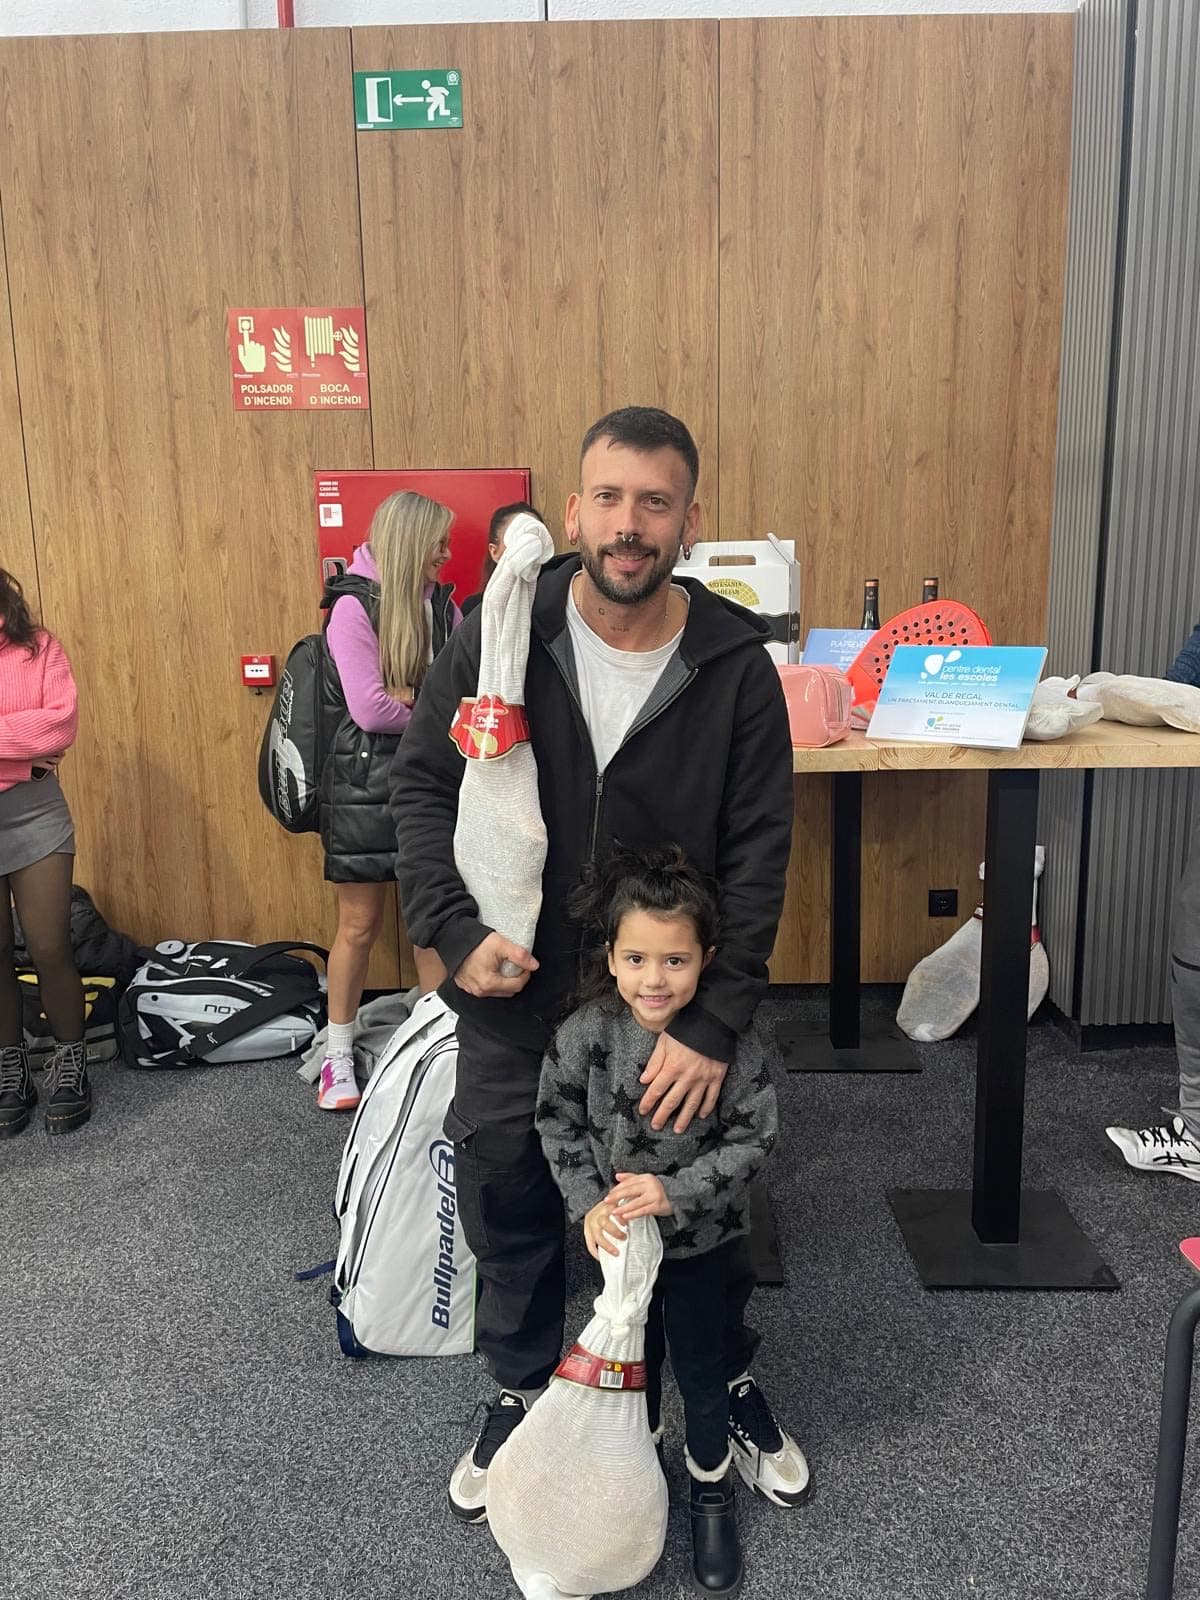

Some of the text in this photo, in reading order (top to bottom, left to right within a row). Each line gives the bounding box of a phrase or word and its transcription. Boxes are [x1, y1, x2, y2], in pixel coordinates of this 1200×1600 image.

[240, 384, 294, 394] POLSADOR
[320, 383, 350, 393] BOCA
[942, 664, 1001, 674] centre dental
[940, 672, 998, 682] les escoles
[925, 691, 940, 699] VAL
[955, 692, 983, 700] REGAL
[432, 1182, 457, 1329] Bullpadel
